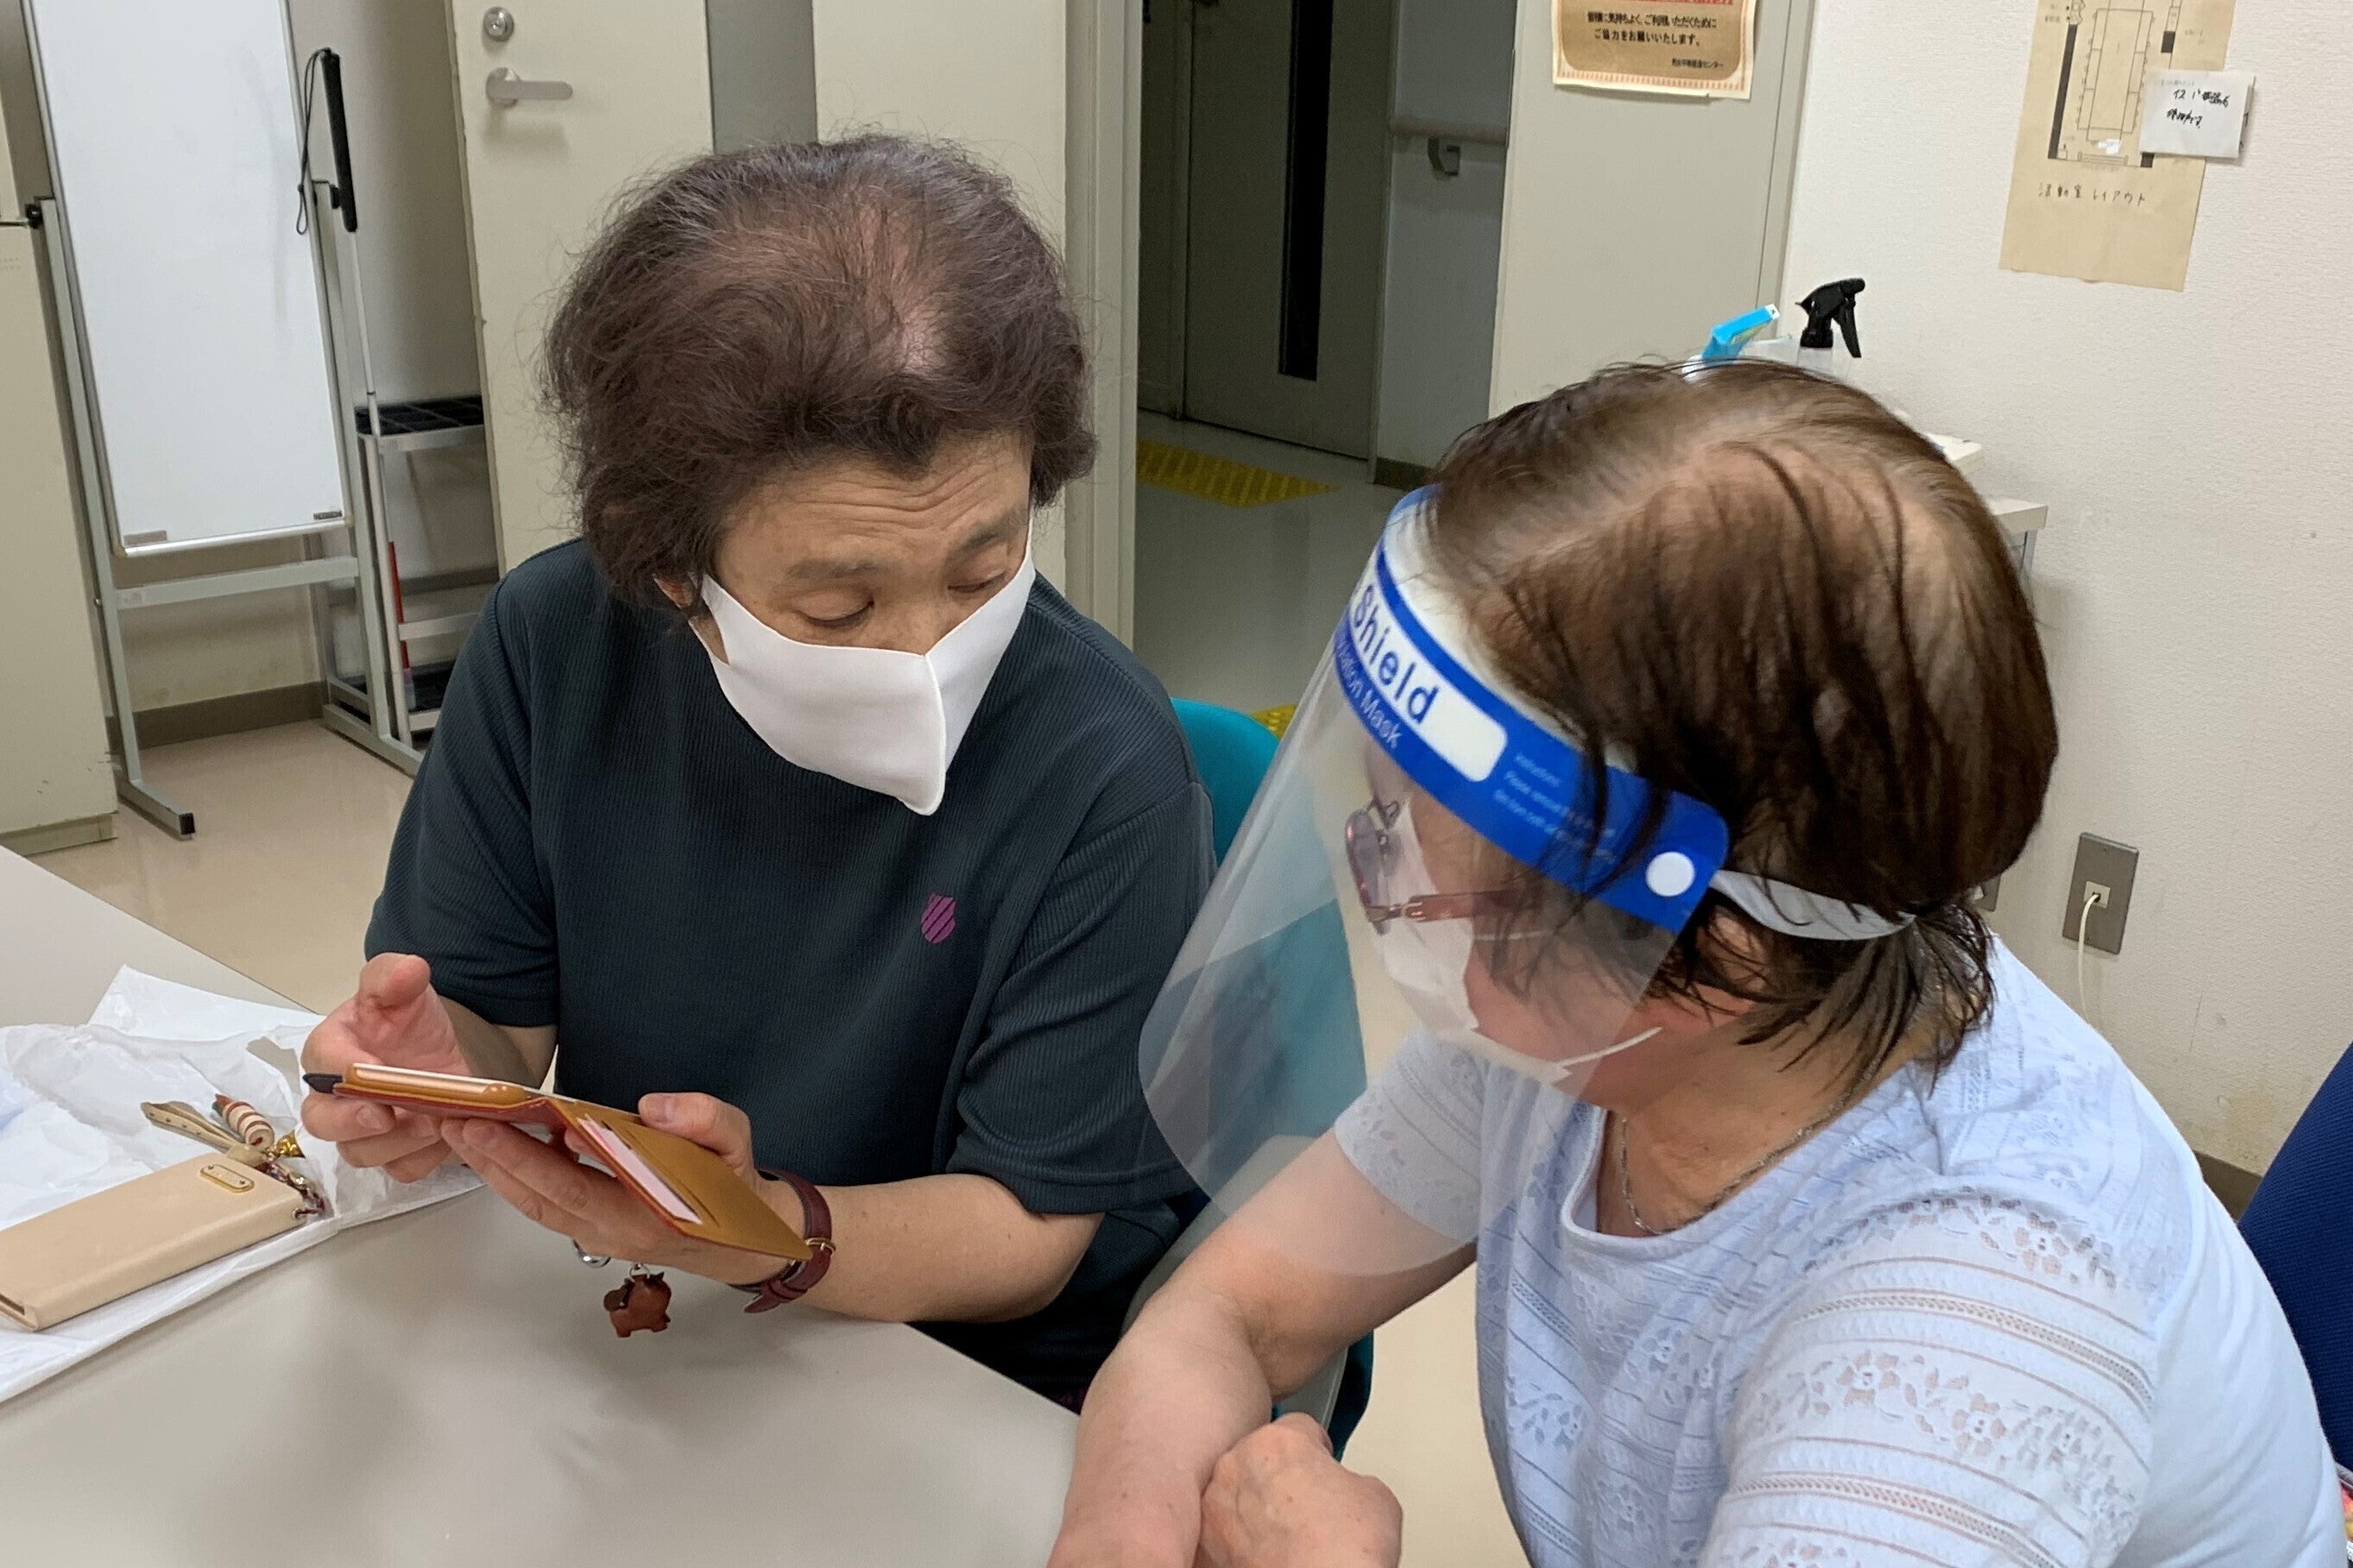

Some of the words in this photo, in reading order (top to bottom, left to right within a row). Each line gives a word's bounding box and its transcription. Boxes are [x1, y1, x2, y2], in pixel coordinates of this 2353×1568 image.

[1594, 28, 1700, 47] ご協力をお願いいたします。
[1353, 582, 1440, 725] Shield
[1359, 689, 1403, 750] Mask
